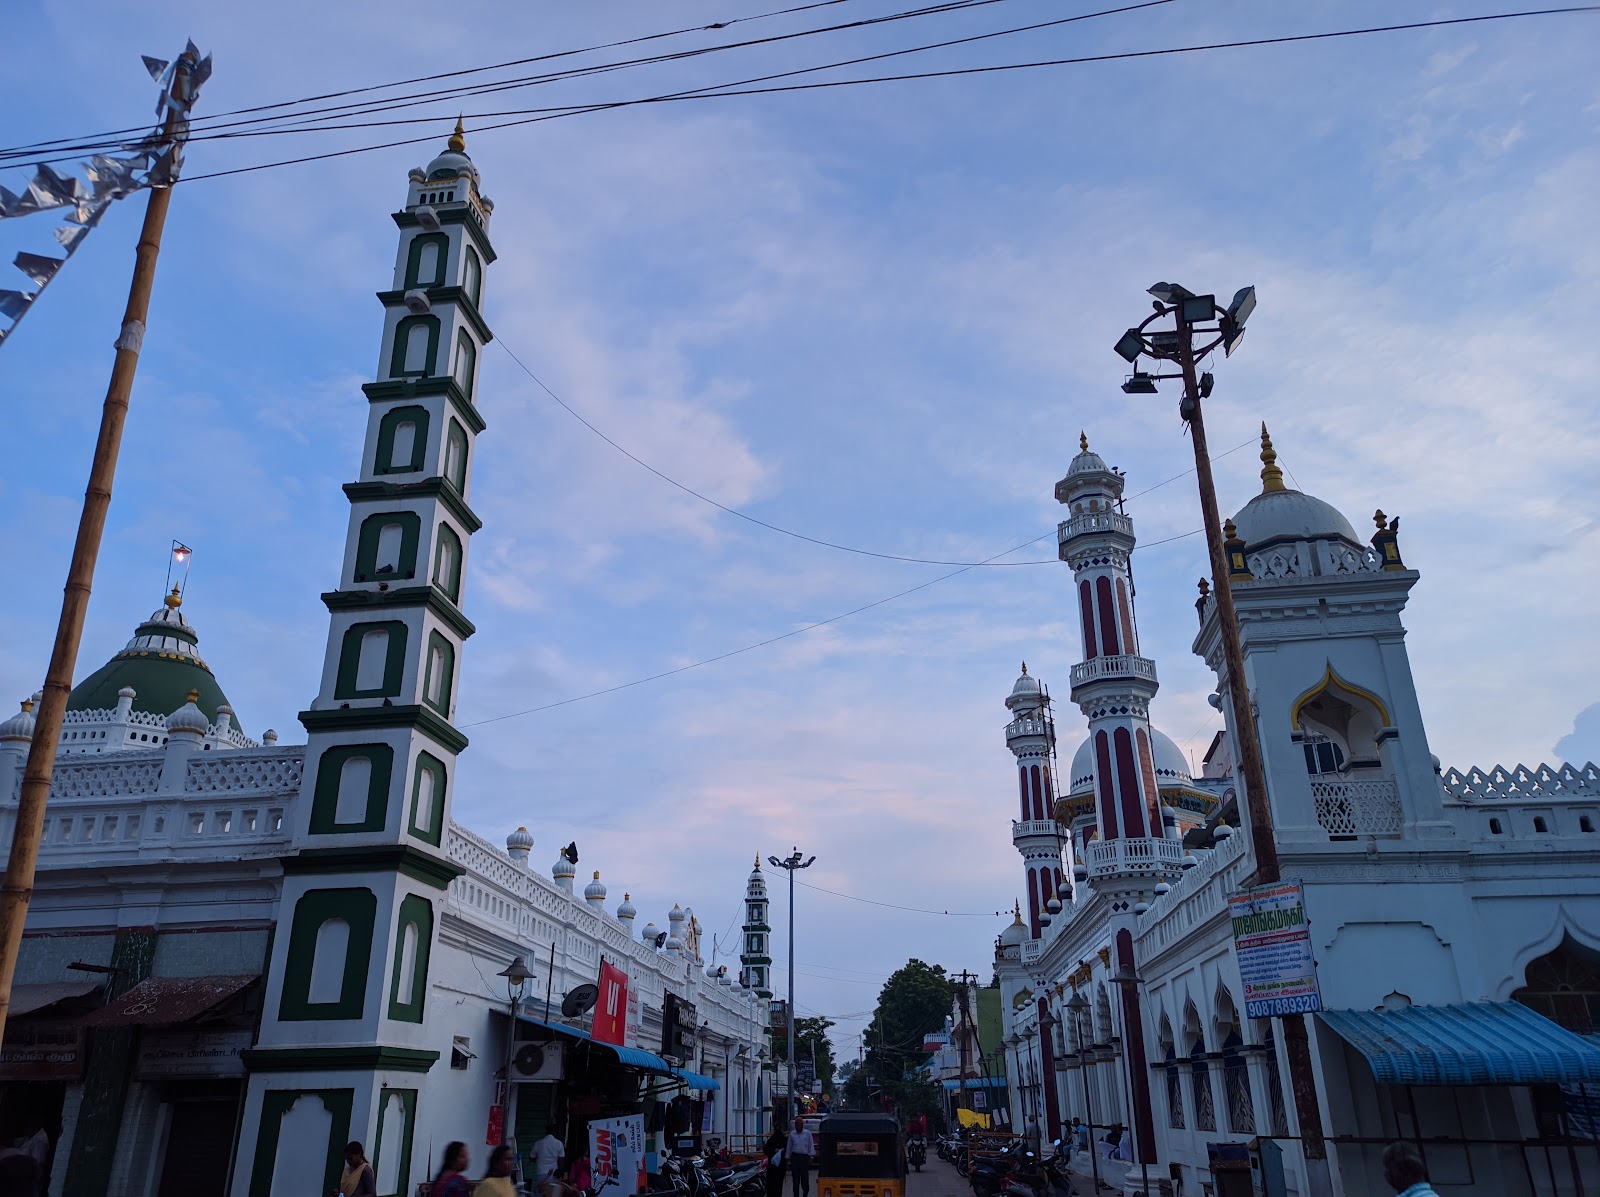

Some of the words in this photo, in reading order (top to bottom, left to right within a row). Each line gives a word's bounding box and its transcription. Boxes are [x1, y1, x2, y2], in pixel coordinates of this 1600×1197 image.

[1245, 984, 1252, 993] 3
[1249, 996, 1318, 1017] 9087889320
[596, 1129, 612, 1177] SUN
